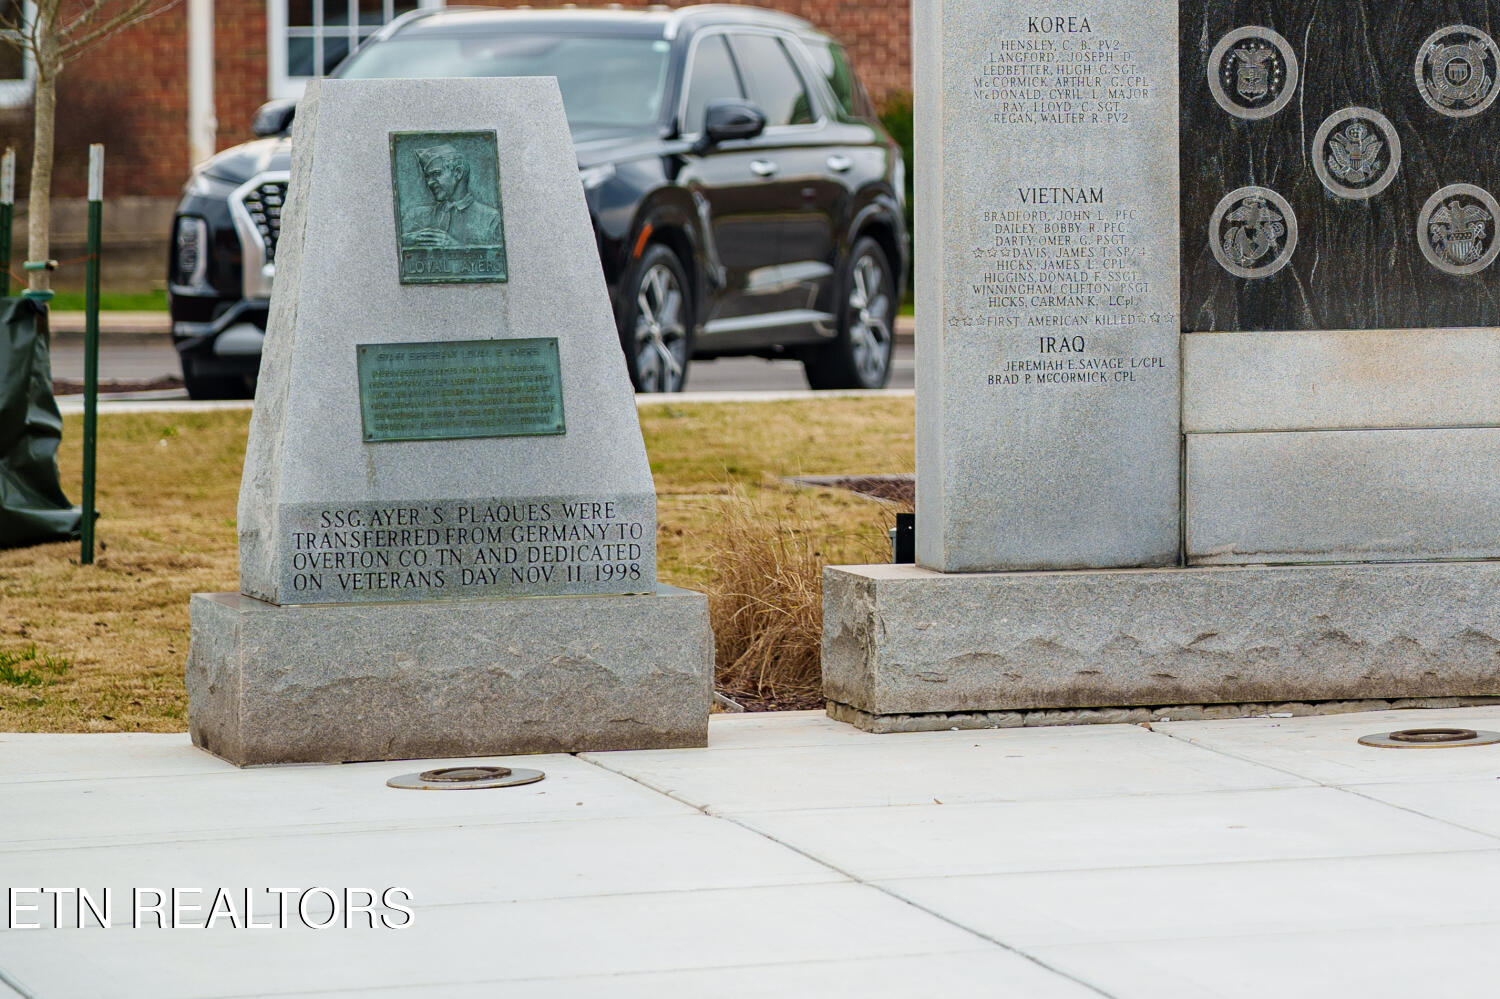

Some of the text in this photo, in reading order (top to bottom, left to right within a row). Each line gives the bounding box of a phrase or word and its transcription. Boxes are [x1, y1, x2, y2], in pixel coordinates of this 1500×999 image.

[1028, 17, 1092, 33] KOREA
[1018, 187, 1104, 204] VIETNAM
[1031, 296, 1086, 307] CARMAN
[986, 314, 1135, 327] FIRST AMERICAN KILLED
[1040, 336, 1086, 353] IRAQ
[1004, 360, 1063, 372] JEREMIAH
[1079, 358, 1123, 370] SAVAGE
[1131, 357, 1165, 368] L/CPL
[988, 374, 1019, 385] BRAD
[1114, 371, 1136, 382] CPL
[321, 501, 616, 529] SSG. AYER'S PLAQUES WERE
[293, 522, 642, 550] TRANSFERRED FROM GERMANY TO
[294, 543, 641, 571] OVERTON CO. TN AND DEDICATED
[294, 572, 323, 591] ON
[338, 569, 445, 590] VETERANS
[461, 567, 501, 586] DAY
[595, 563, 641, 582] 1998
